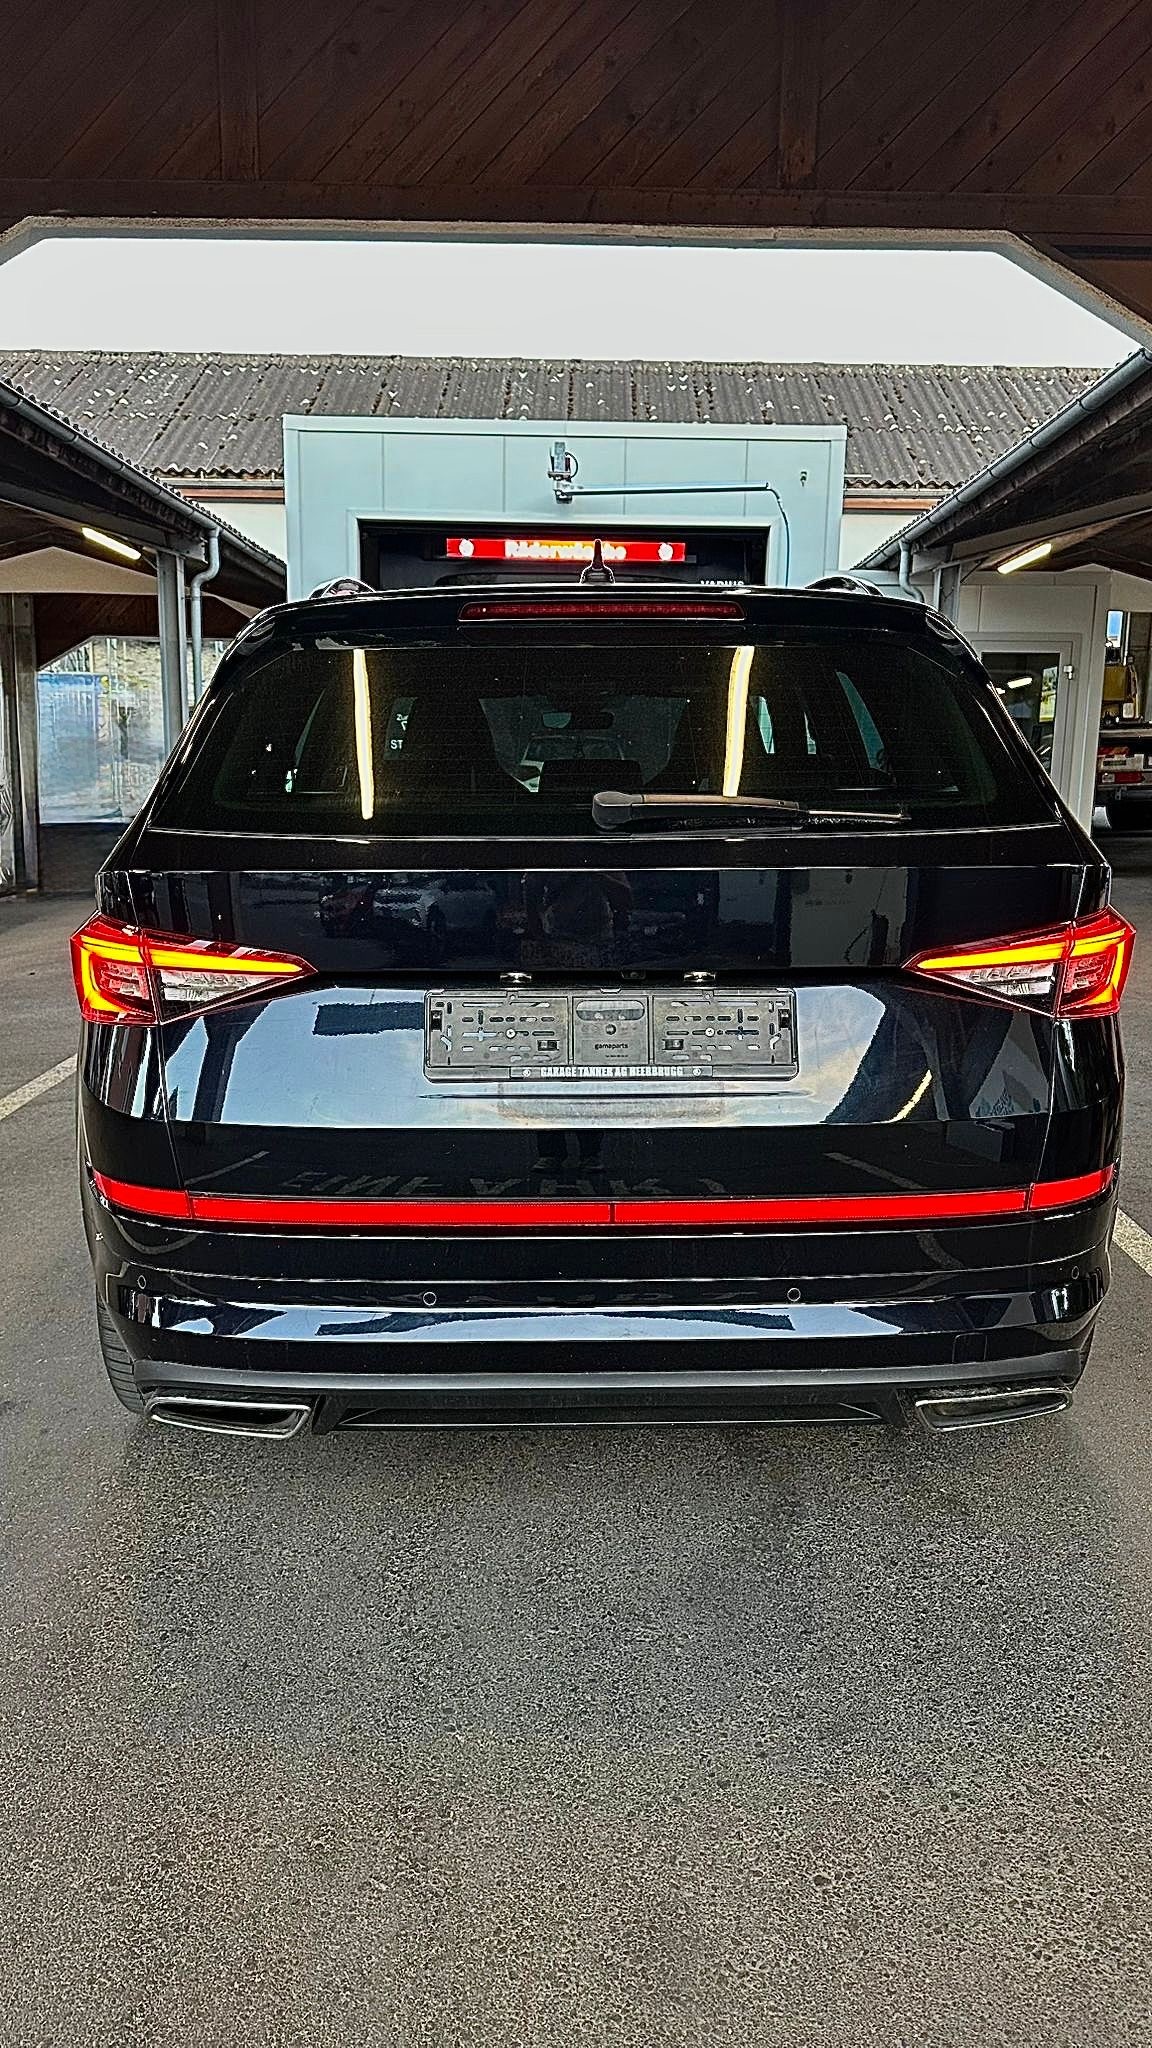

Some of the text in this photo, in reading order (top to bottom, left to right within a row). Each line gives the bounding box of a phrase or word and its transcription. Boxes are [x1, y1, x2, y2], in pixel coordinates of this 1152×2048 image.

[540, 1066, 684, 1078] GARAGE TANNER AG HEERBRUGG
